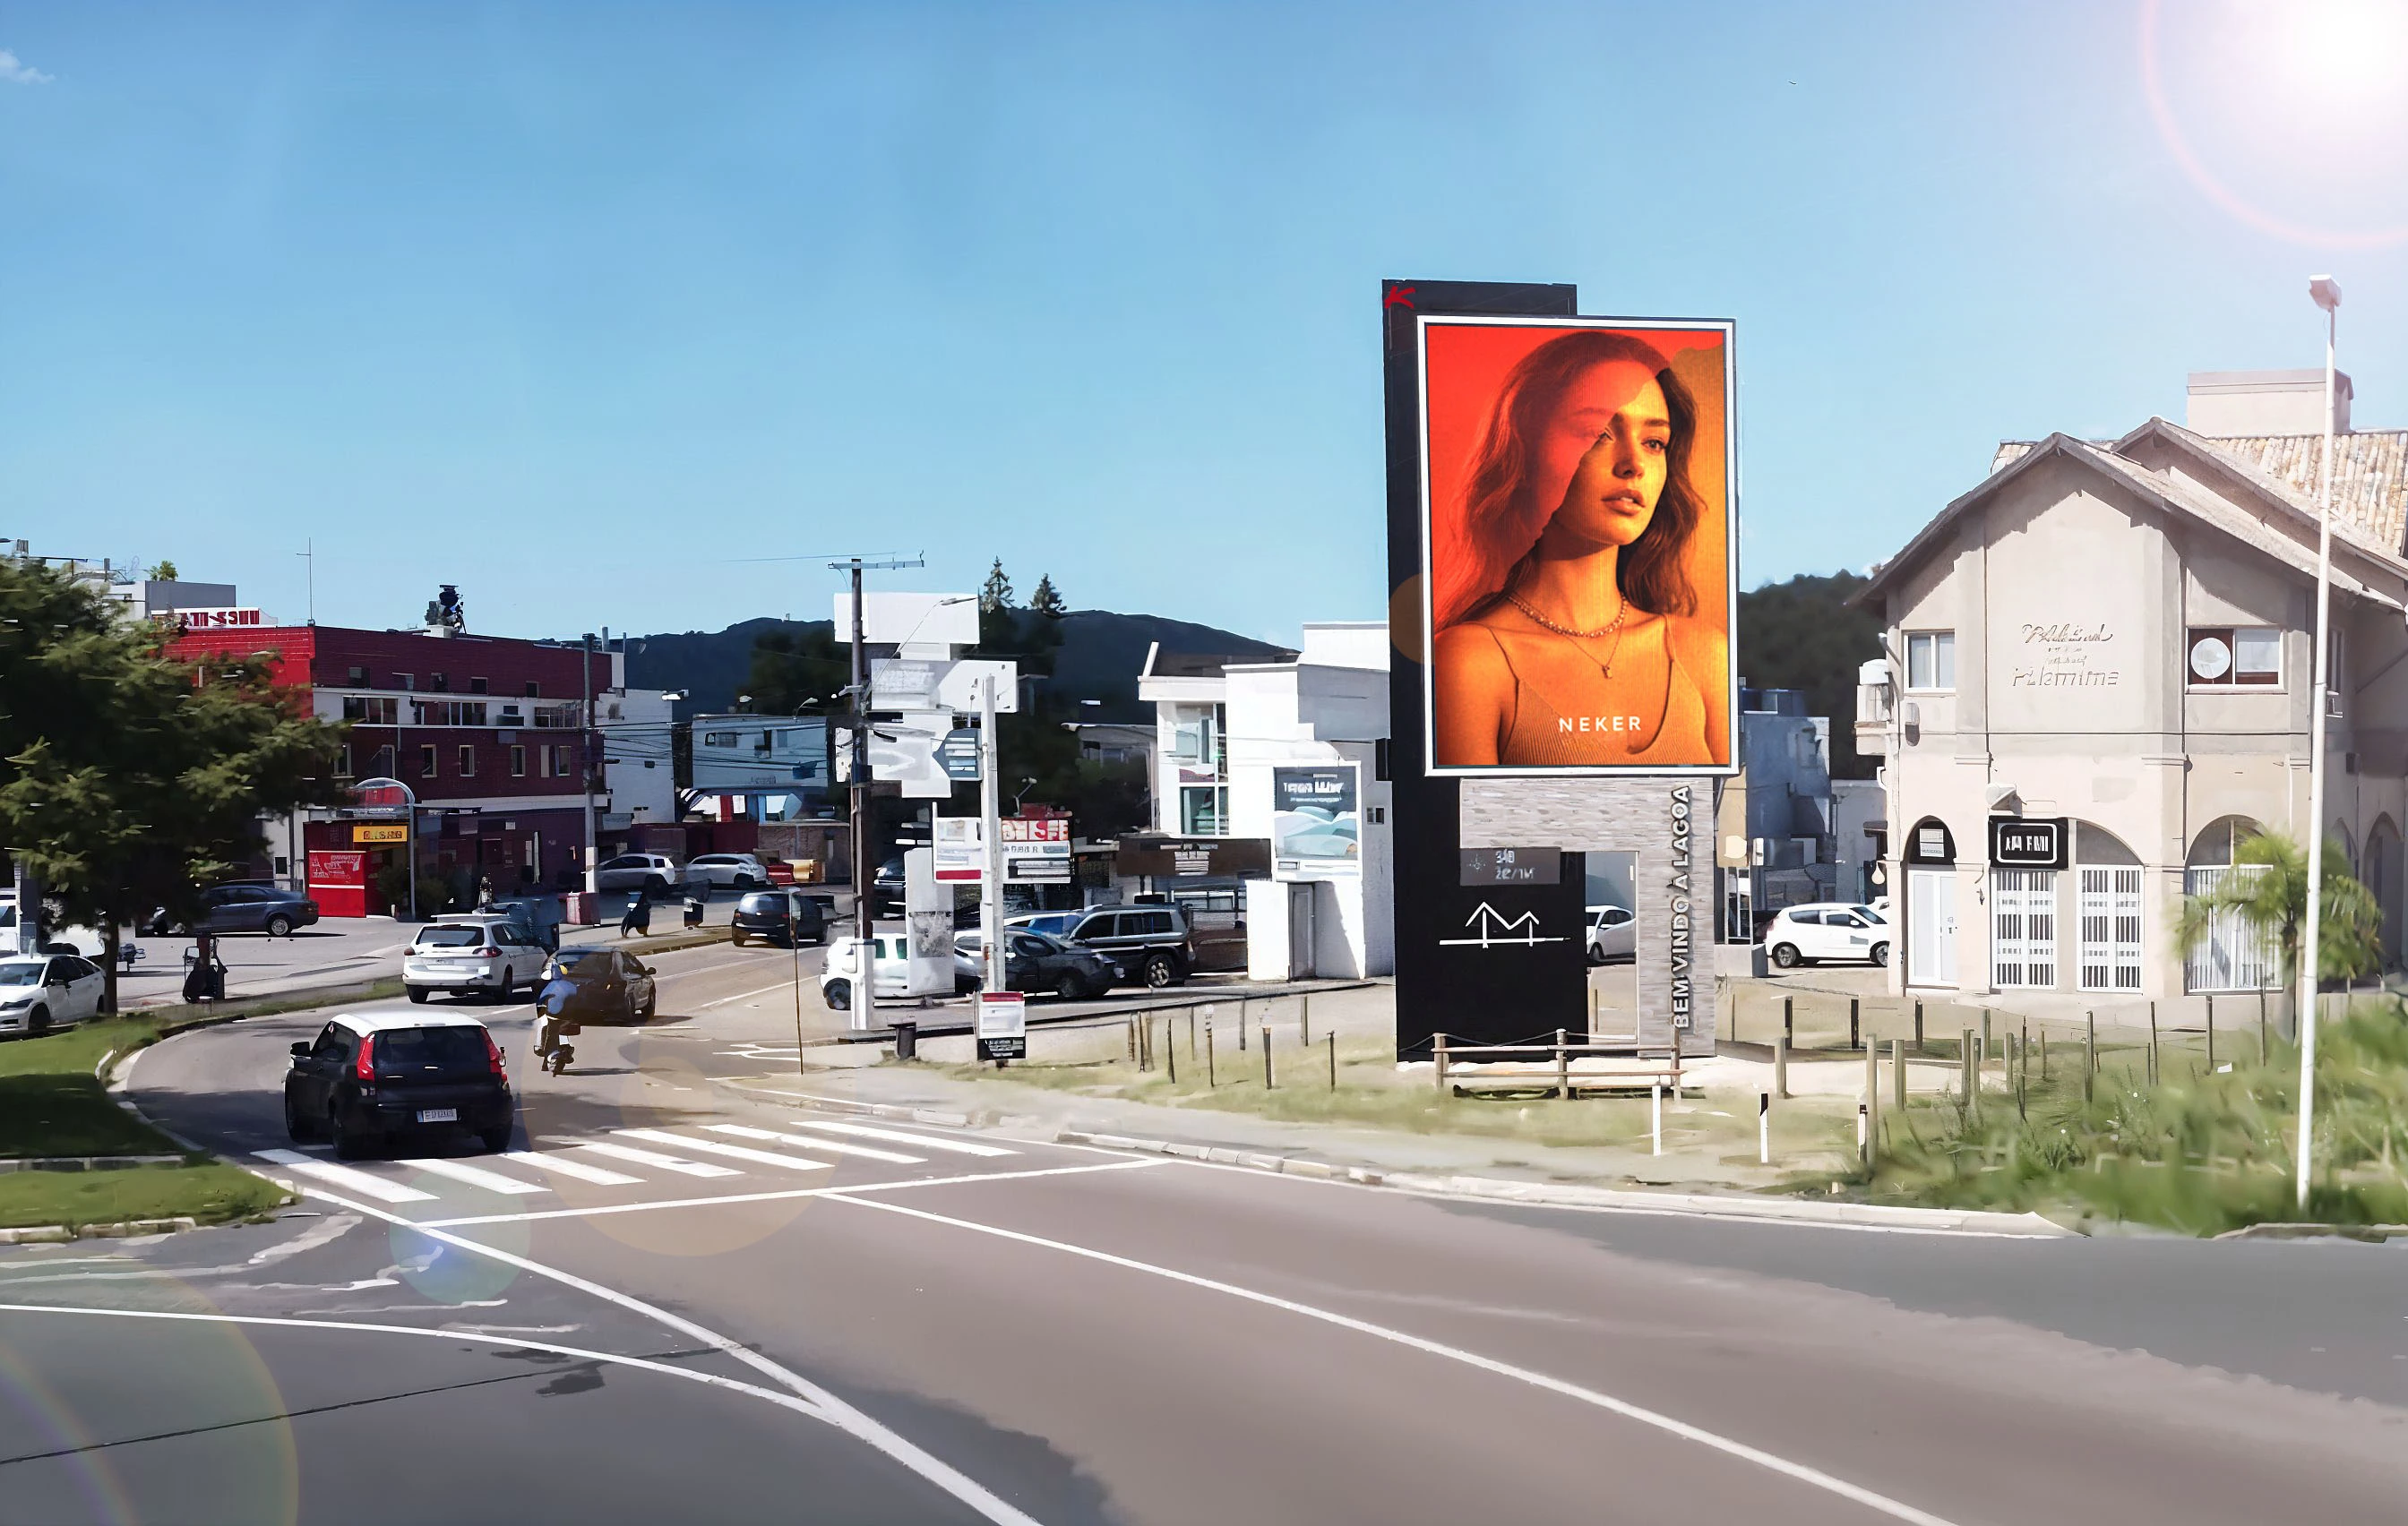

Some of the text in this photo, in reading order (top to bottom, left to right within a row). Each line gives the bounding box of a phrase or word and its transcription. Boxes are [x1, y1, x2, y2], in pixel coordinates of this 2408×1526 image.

[1559, 716, 1641, 733] NEKER
[1672, 786, 1690, 867] LAGOA
[1672, 896, 1690, 972] VINDO
[1672, 976, 1690, 1029] BEM
